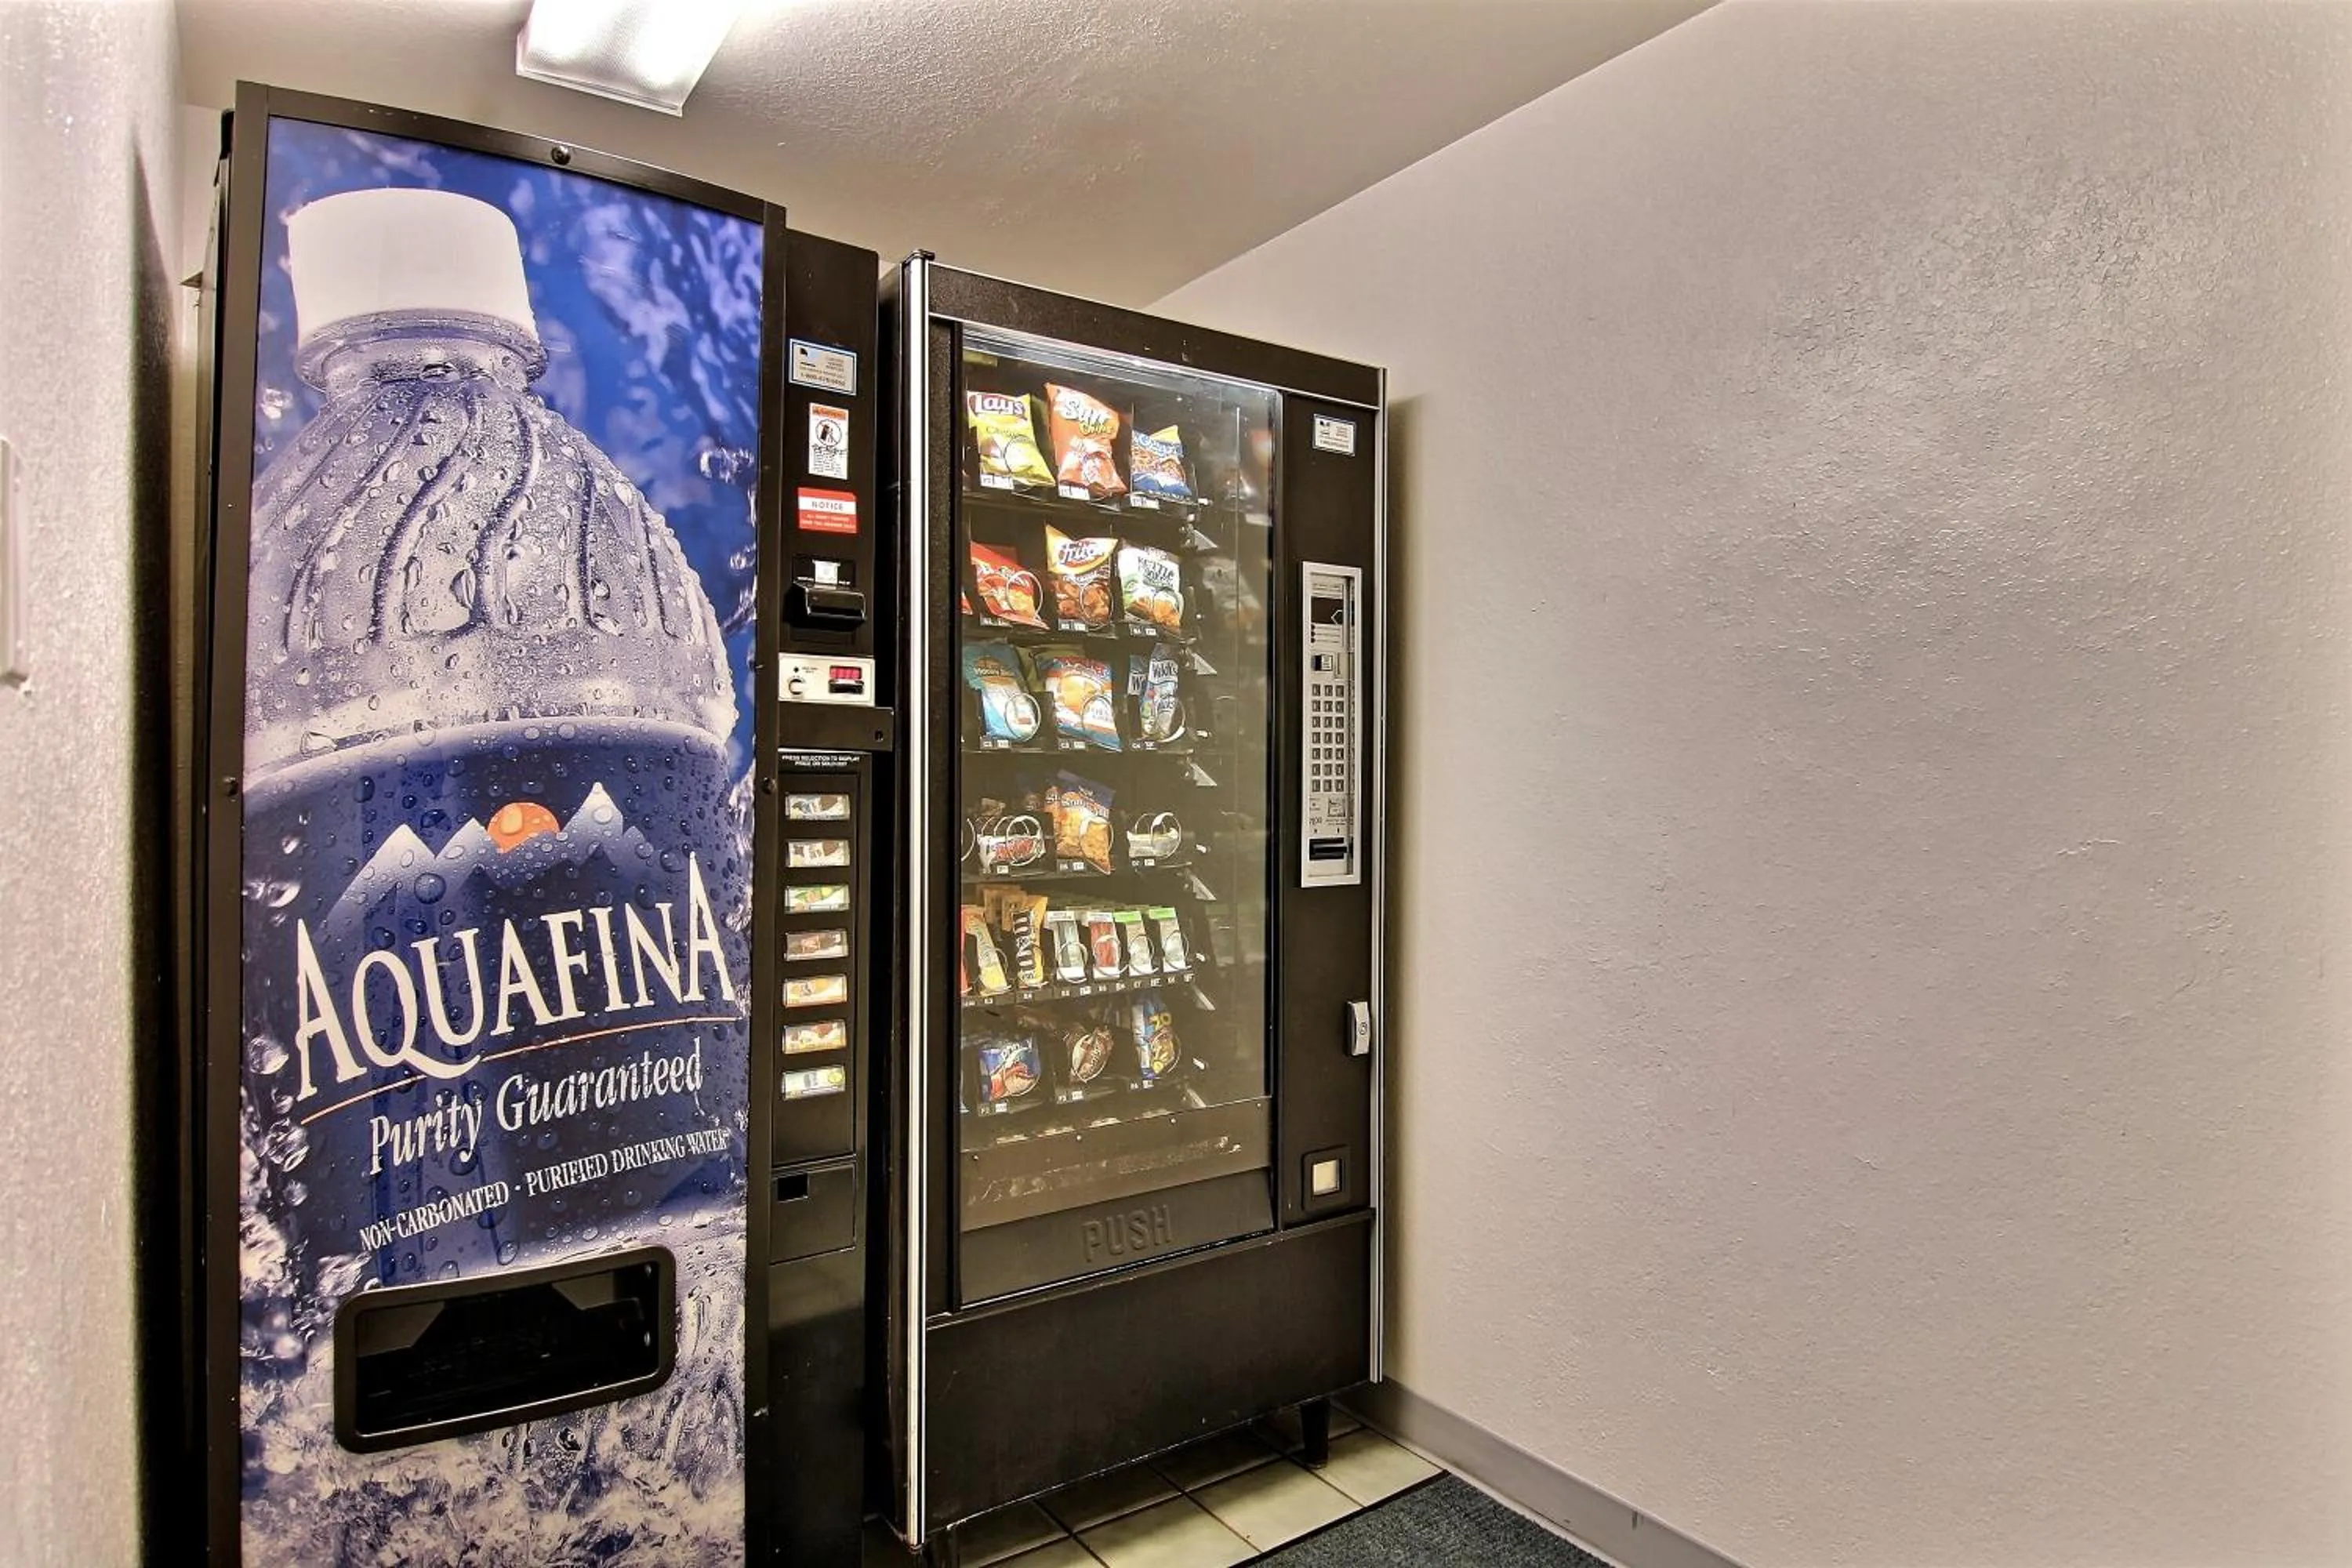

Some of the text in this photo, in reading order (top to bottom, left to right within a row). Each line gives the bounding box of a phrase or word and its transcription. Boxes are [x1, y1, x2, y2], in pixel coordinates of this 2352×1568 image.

[811, 501, 844, 511] NOTICE
[296, 851, 735, 1102] AQUAFINA
[368, 1037, 703, 1175] Purity Guaranteed
[359, 1181, 510, 1251] NON-CARBONATED
[524, 1152, 608, 1197] PURIFIED
[612, 1134, 687, 1174] DRINKING
[1081, 1203, 1173, 1264] PUSH
